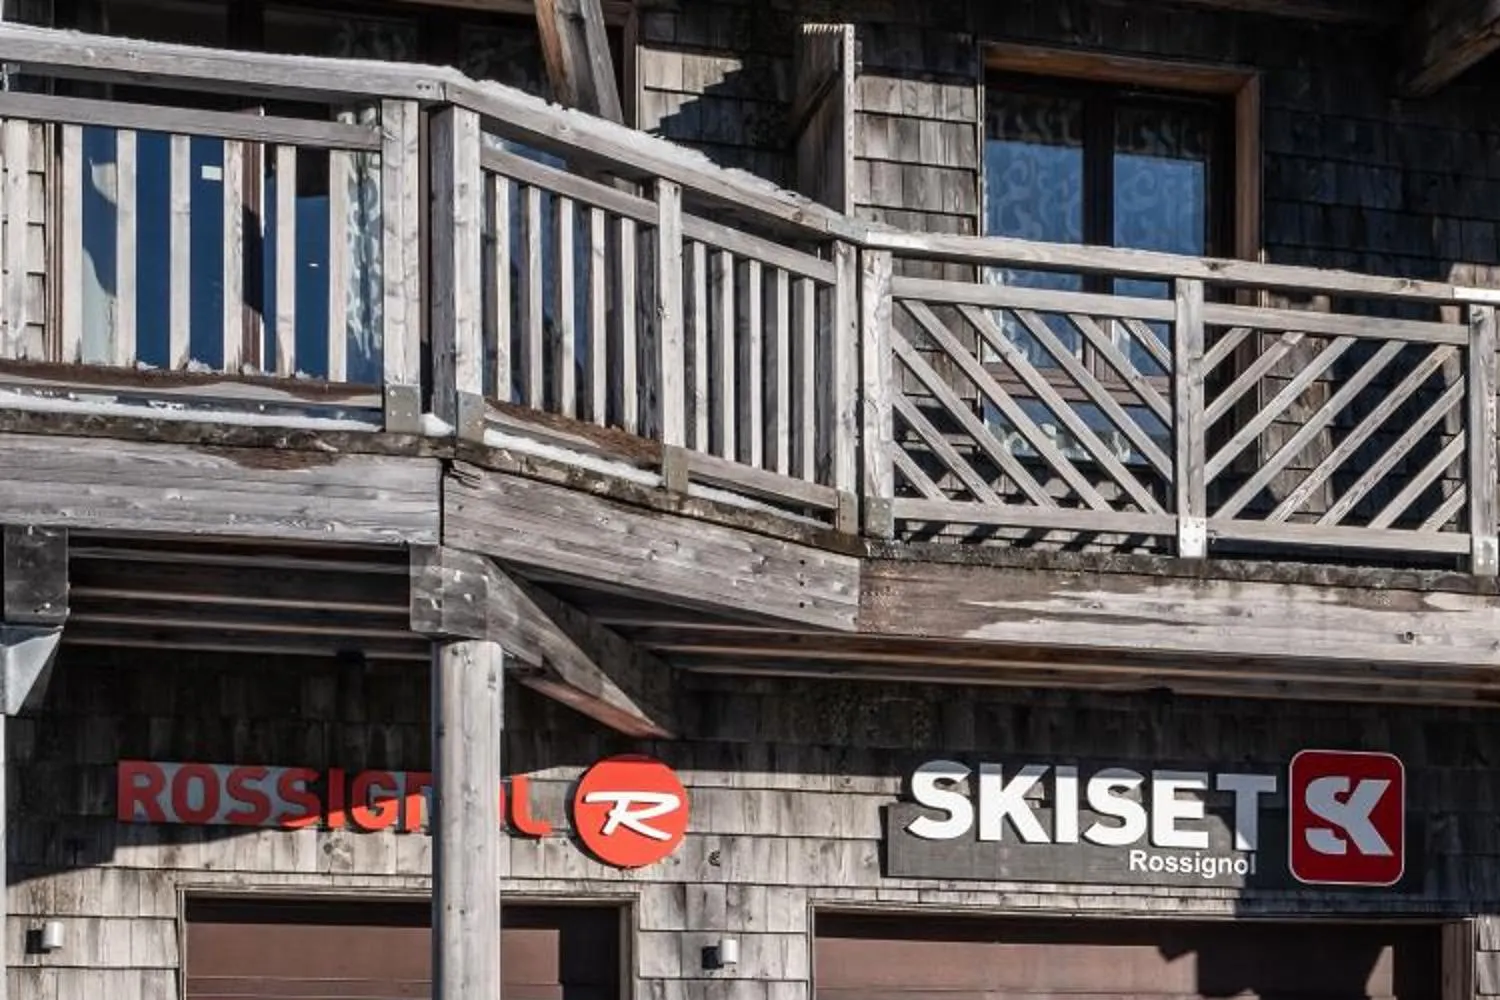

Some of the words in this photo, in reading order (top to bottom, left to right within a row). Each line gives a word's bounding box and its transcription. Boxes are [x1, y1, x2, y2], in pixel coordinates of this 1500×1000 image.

[117, 760, 553, 837] ROSSIGNL
[905, 759, 1277, 851] SKISET
[1129, 849, 1257, 880] Rossignol
